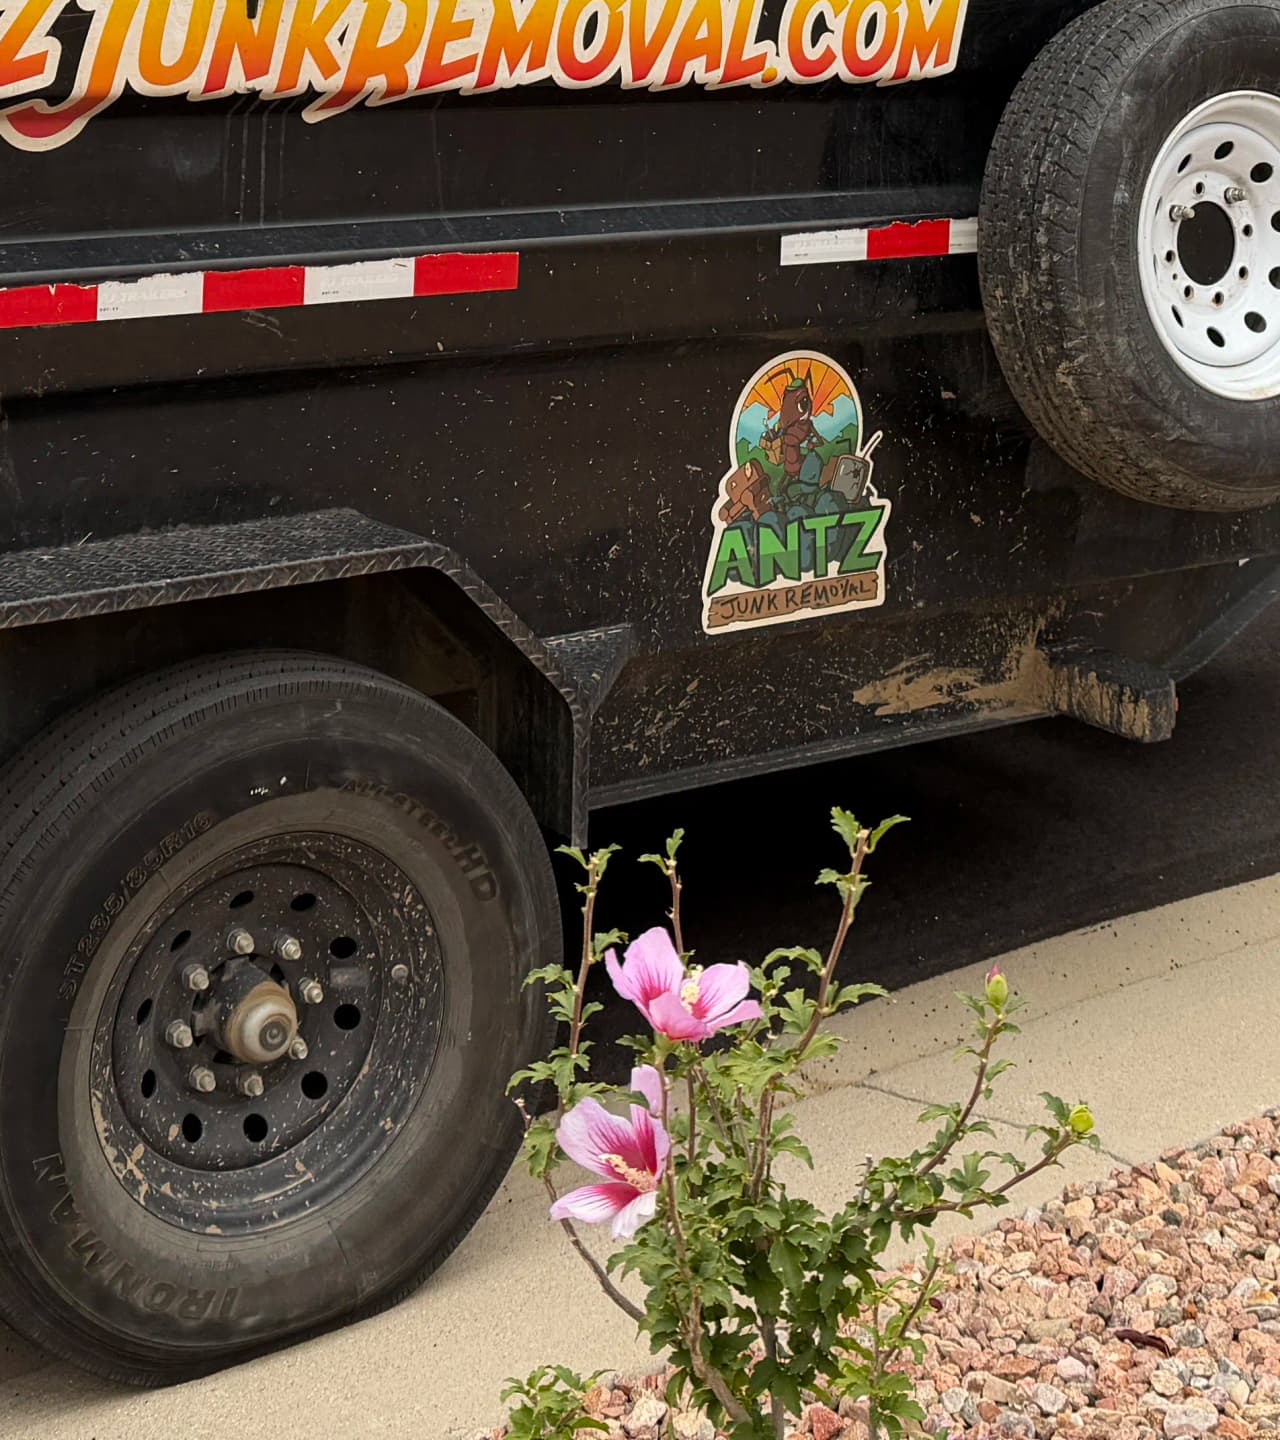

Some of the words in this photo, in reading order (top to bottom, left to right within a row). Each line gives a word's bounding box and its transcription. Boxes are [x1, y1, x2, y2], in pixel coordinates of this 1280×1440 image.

[706, 505, 886, 598] ANTZ
[720, 592, 779, 620] JUNK
[784, 576, 872, 610] REMOVAL
